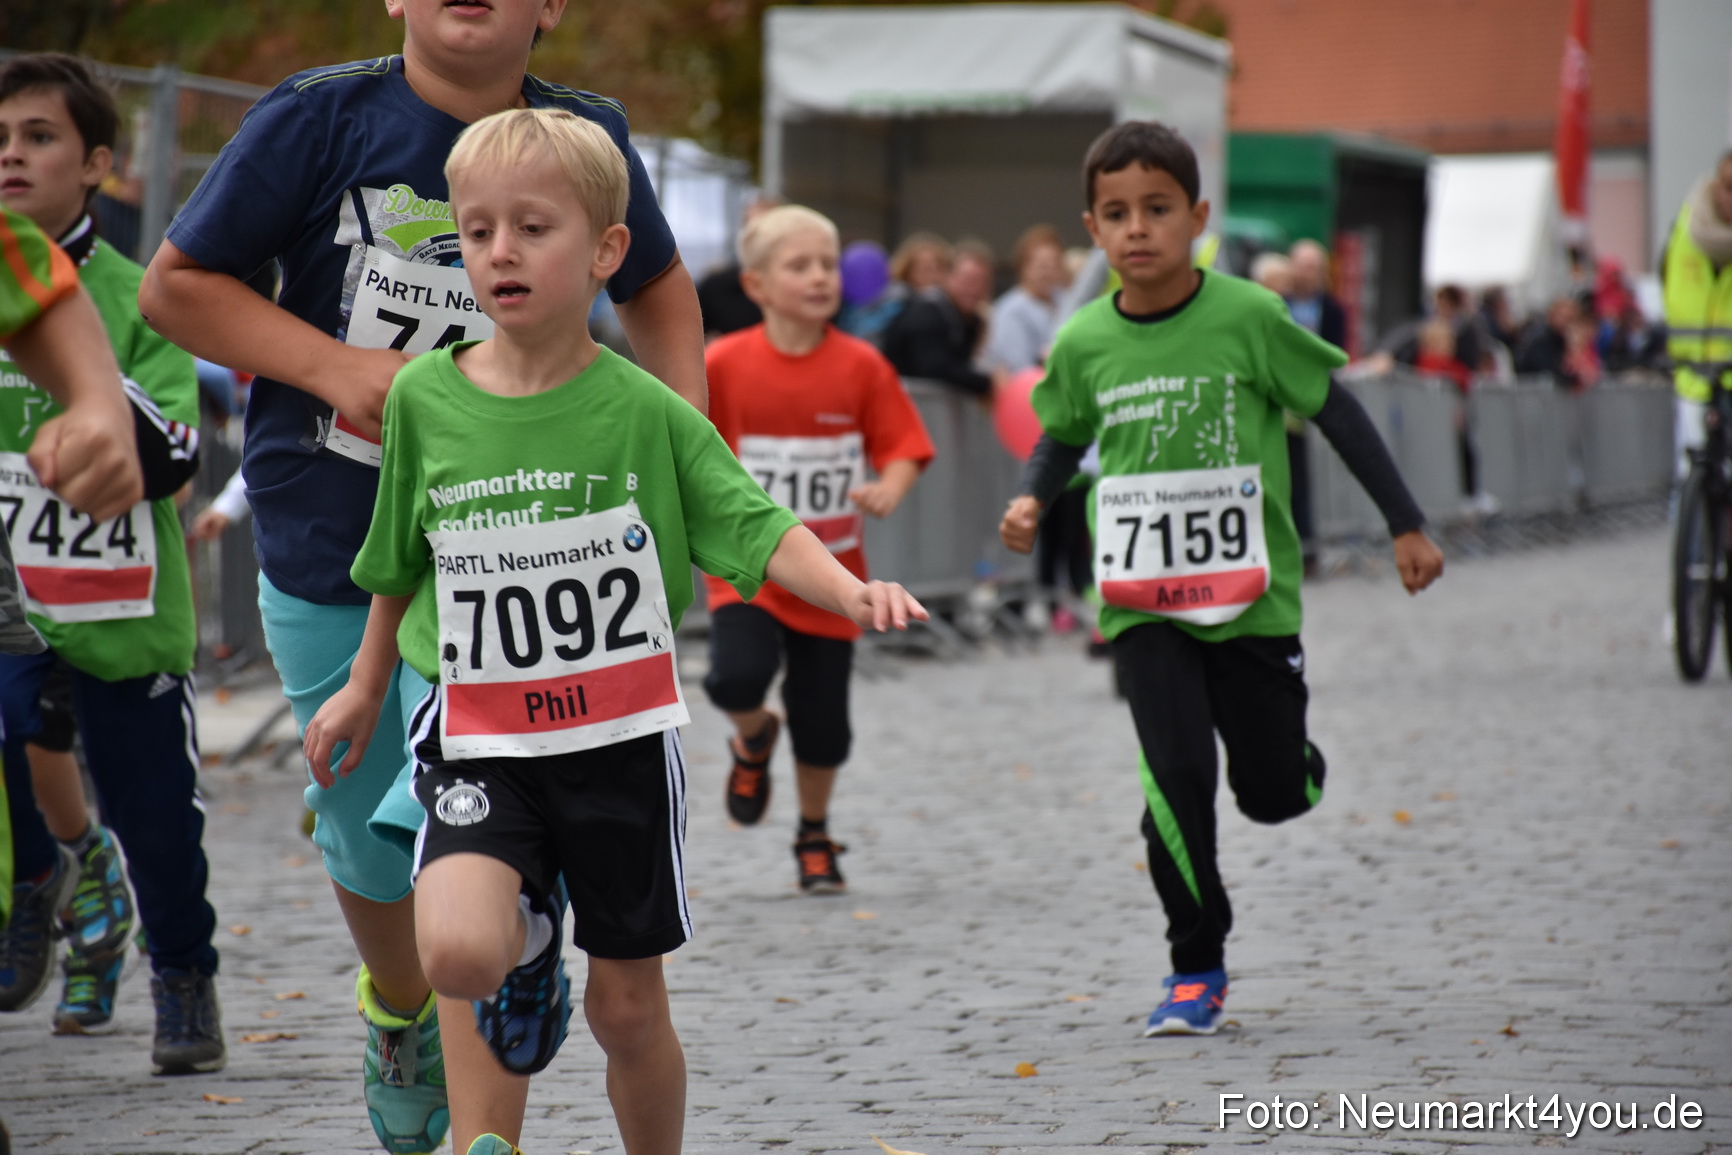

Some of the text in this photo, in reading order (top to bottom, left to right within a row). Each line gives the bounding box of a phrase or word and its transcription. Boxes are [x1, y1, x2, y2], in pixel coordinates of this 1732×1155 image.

[365, 268, 438, 307] PARTL
[427, 468, 575, 509] Neumarkter
[754, 468, 853, 512] 7167
[1102, 486, 1234, 508] PARTL Neumarkt
[0, 496, 136, 557] 7424
[1117, 507, 1247, 570] 7159
[438, 554, 494, 575] PARTL
[498, 538, 615, 573] Neumarkt
[453, 567, 648, 670] 7092
[524, 685, 588, 723] Phil
